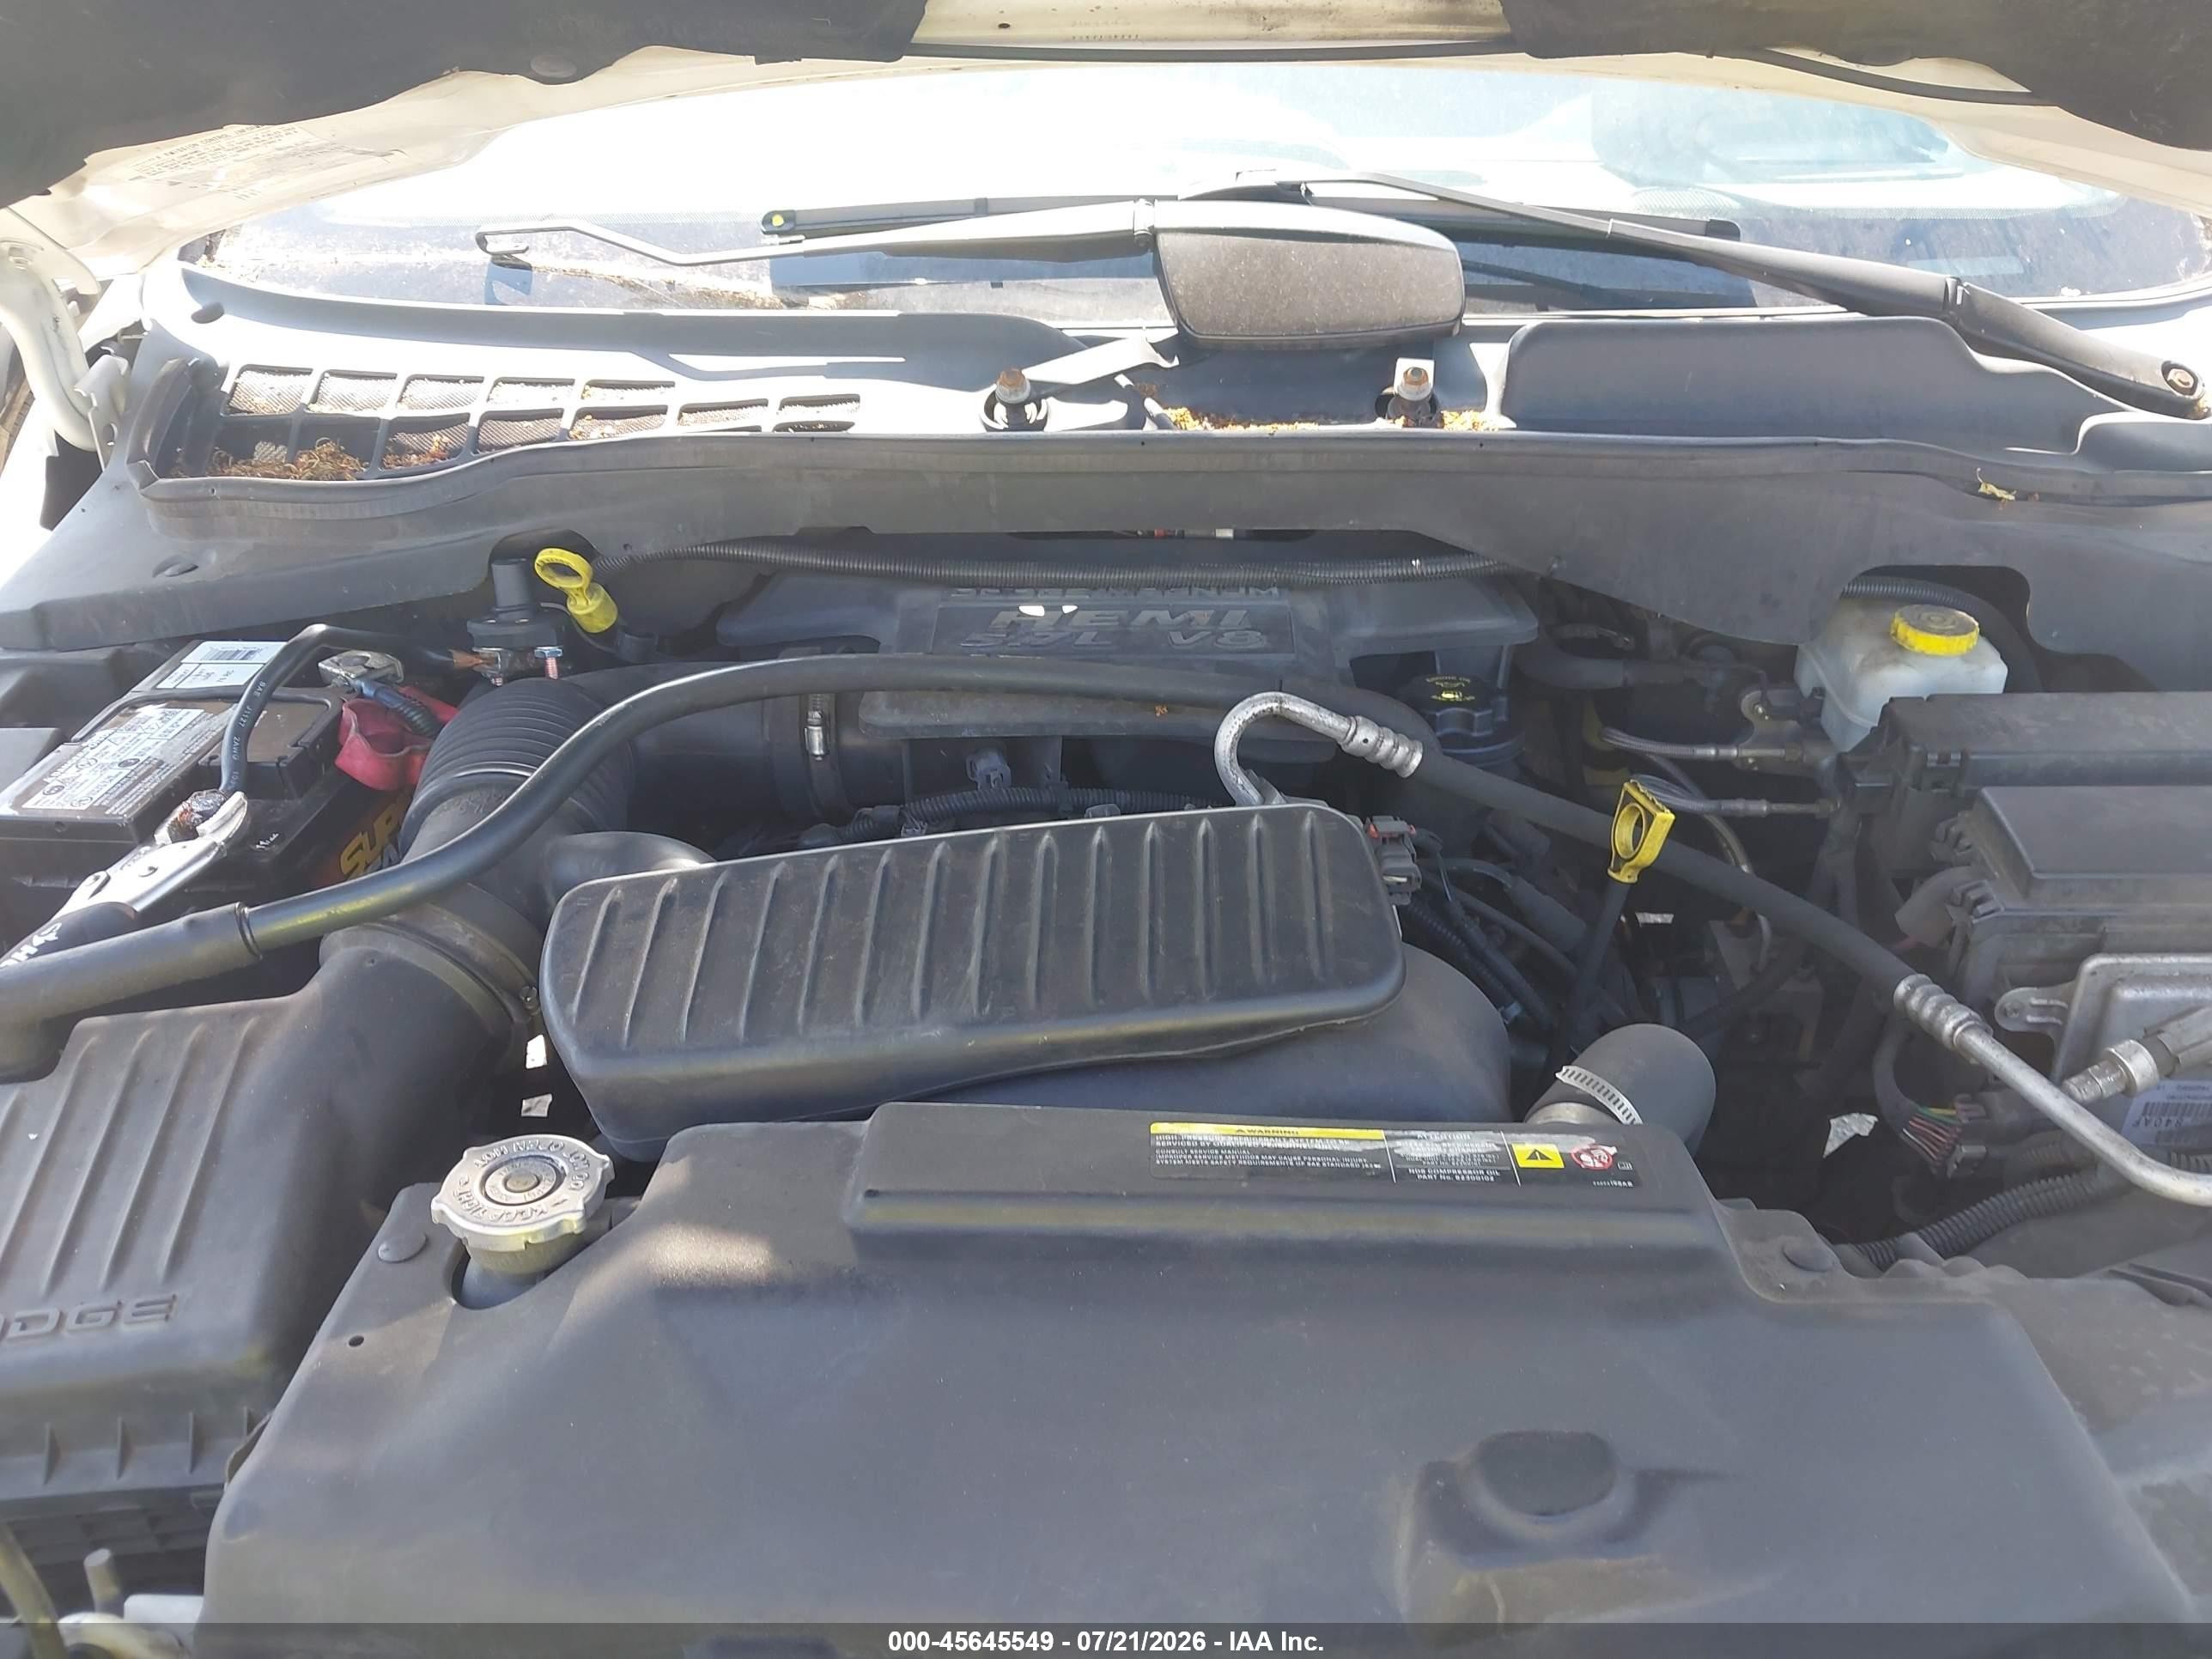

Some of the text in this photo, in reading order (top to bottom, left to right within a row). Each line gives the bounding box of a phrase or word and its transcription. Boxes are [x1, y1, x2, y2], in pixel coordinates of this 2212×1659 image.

[989, 610, 1250, 629] HEMI
[1168, 629, 1264, 649] V8
[0, 1294, 177, 1343] DGE
